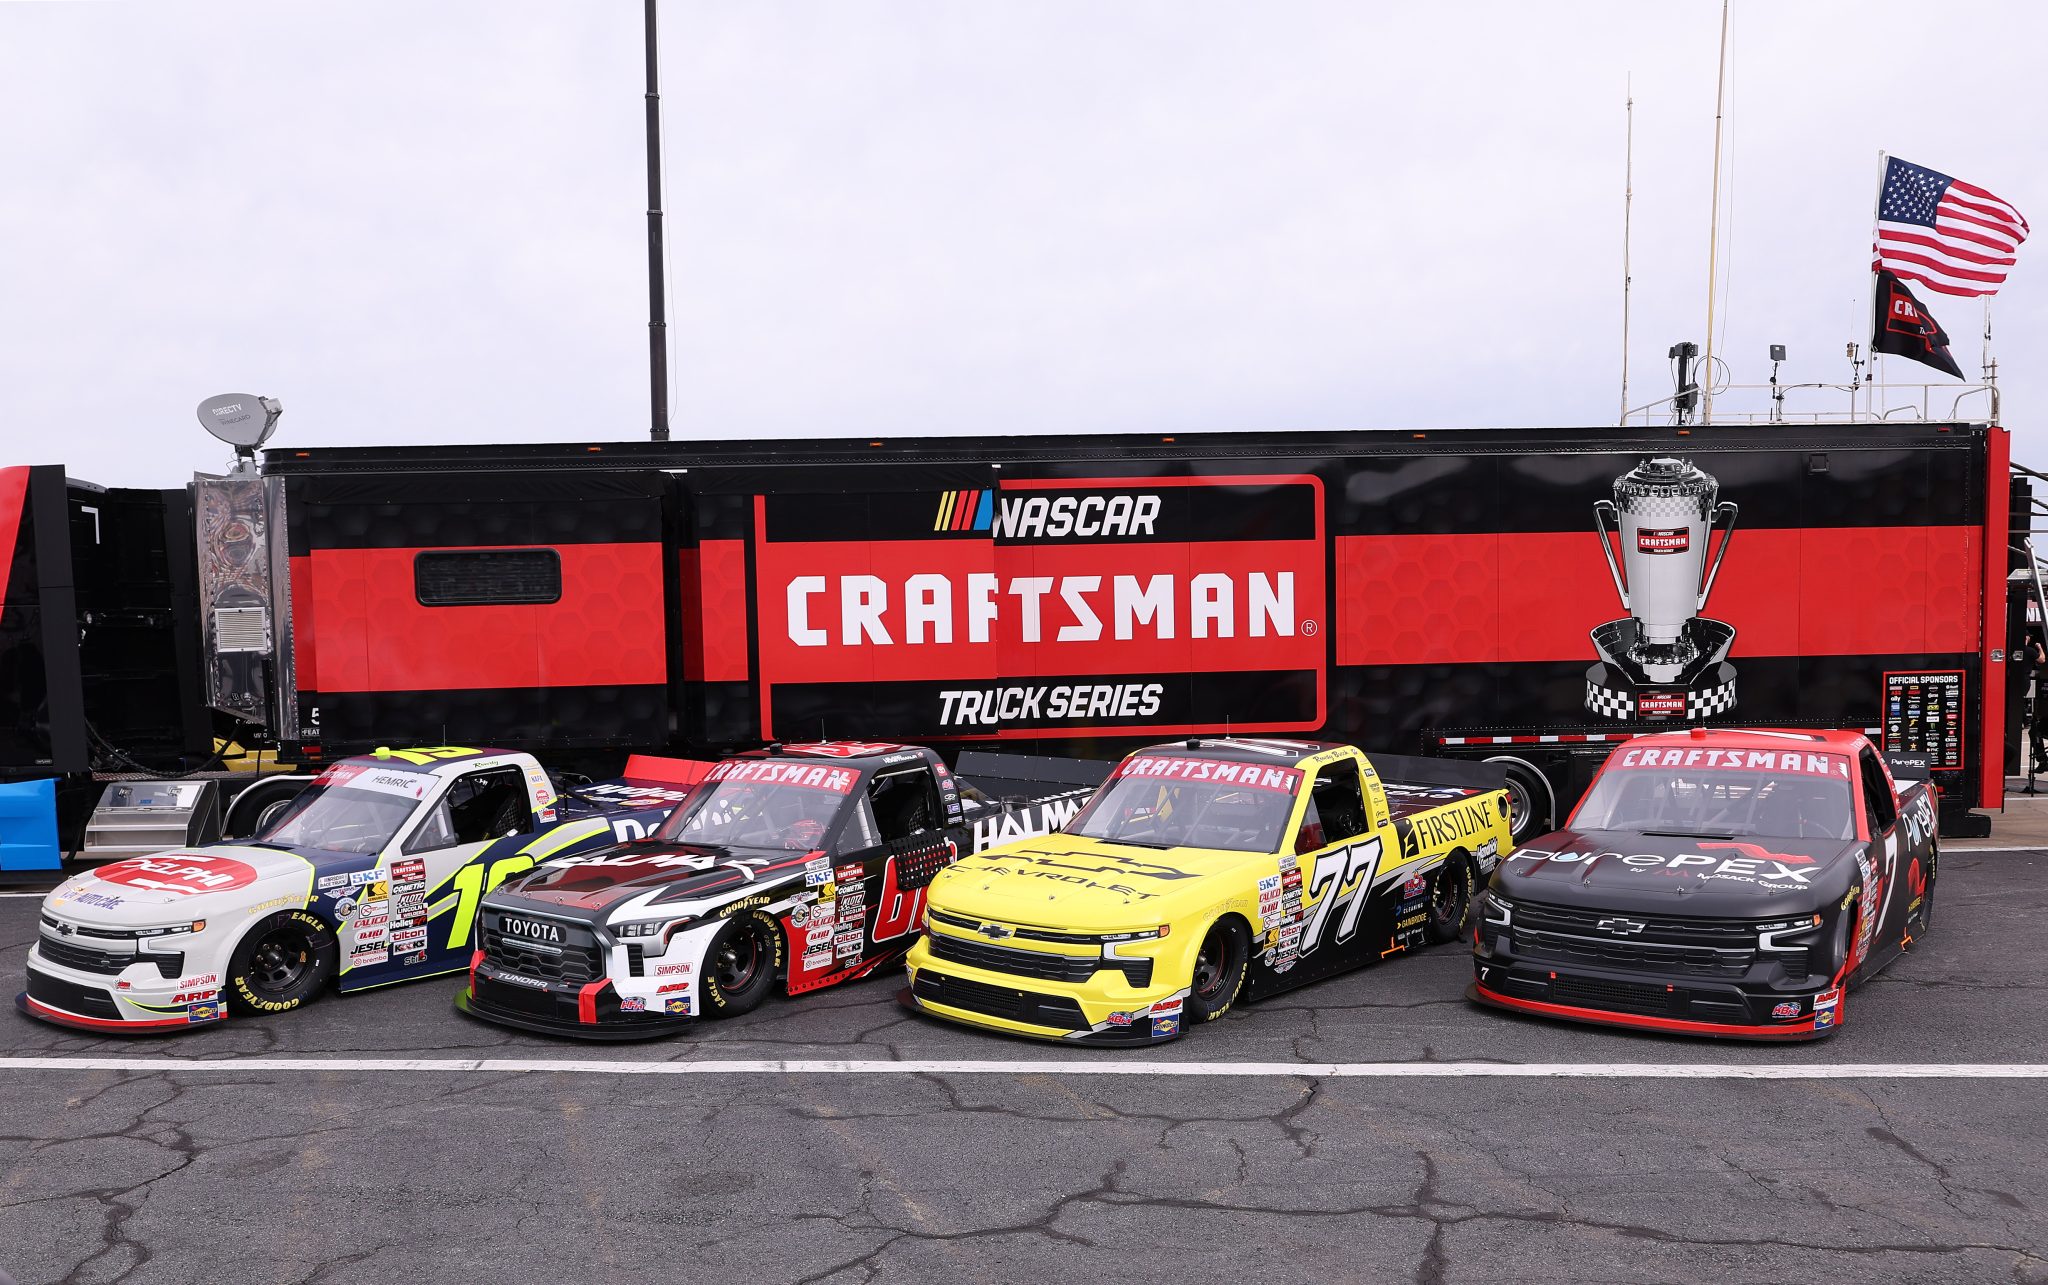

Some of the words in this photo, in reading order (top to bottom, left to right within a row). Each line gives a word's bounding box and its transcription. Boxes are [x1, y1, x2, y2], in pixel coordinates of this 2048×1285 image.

[212, 403, 242, 416] DIRECTV
[993, 494, 1161, 538] NASCAR
[1640, 537, 1686, 547] CRAFTSMAN
[787, 570, 1296, 646] CRAFTSMAN
[1889, 676, 1920, 684] OFFICIAL
[1920, 675, 1959, 683] SPONSORS
[938, 684, 1049, 726] TRUCK
[1046, 682, 1164, 718] SERIES
[1641, 701, 1683, 709] CRAFTSMAN
[1622, 749, 1829, 774] CRAFTSMAN
[703, 761, 849, 791] CRAFTSMAN
[1121, 757, 1285, 788] CRAFTSMAN
[371, 774, 411, 789] HEMRIC
[1416, 800, 1493, 850] FIRSTLINE
[121, 858, 235, 888] DELPHI
[352, 869, 385, 885] SKF
[807, 870, 832, 885] SKF
[946, 863, 1161, 900] CHEVROLET
[1259, 875, 1279, 891] SKF
[1696, 872, 1757, 884] MOSACK
[1757, 879, 1809, 891] GROUP
[400, 892, 424, 904] KLOTZ
[842, 894, 863, 906] KLOTZ
[1259, 888, 1281, 902] CALICO
[1300, 836, 1383, 957] 77
[247, 894, 320, 915] GOODYEAR
[397, 904, 423, 914] LINCOLN
[719, 895, 771, 919] GOODYEAR
[1403, 902, 1424, 914] CLEANING
[291, 911, 325, 932] EAGLE
[353, 915, 389, 929] CALICO
[389, 917, 414, 930] Holley
[805, 916, 835, 929] CALICO
[834, 921, 852, 933] Holley
[1401, 912, 1428, 929] GAINBRIDGE
[391, 929, 426, 941] tilton
[505, 917, 560, 942] TOYOTA
[836, 931, 863, 943] tilton
[1281, 925, 1301, 937] tilton
[752, 909, 782, 968] GOODYEAR
[350, 939, 387, 954] JESEL
[803, 940, 833, 955] JESEL
[1277, 947, 1298, 959] JESEL
[361, 954, 388, 965] brembo
[656, 964, 691, 976] SIMPSON
[1481, 967, 1490, 980] 7
[179, 974, 218, 989] SIMPSON
[497, 972, 549, 988] TUNDRA
[656, 982, 690, 993] ARP
[170, 989, 218, 1004] ARP
[234, 975, 300, 1011] GOODYEAR
[707, 975, 727, 1009] EAGLE
[1815, 991, 1838, 1003] ARP
[190, 1007, 217, 1017] SUNOCO
[665, 1002, 691, 1011] SUNOCO
[1149, 999, 1183, 1013] ARP
[1771, 1005, 1800, 1016] KBM
[1154, 1020, 1178, 1031] SUNOCO
